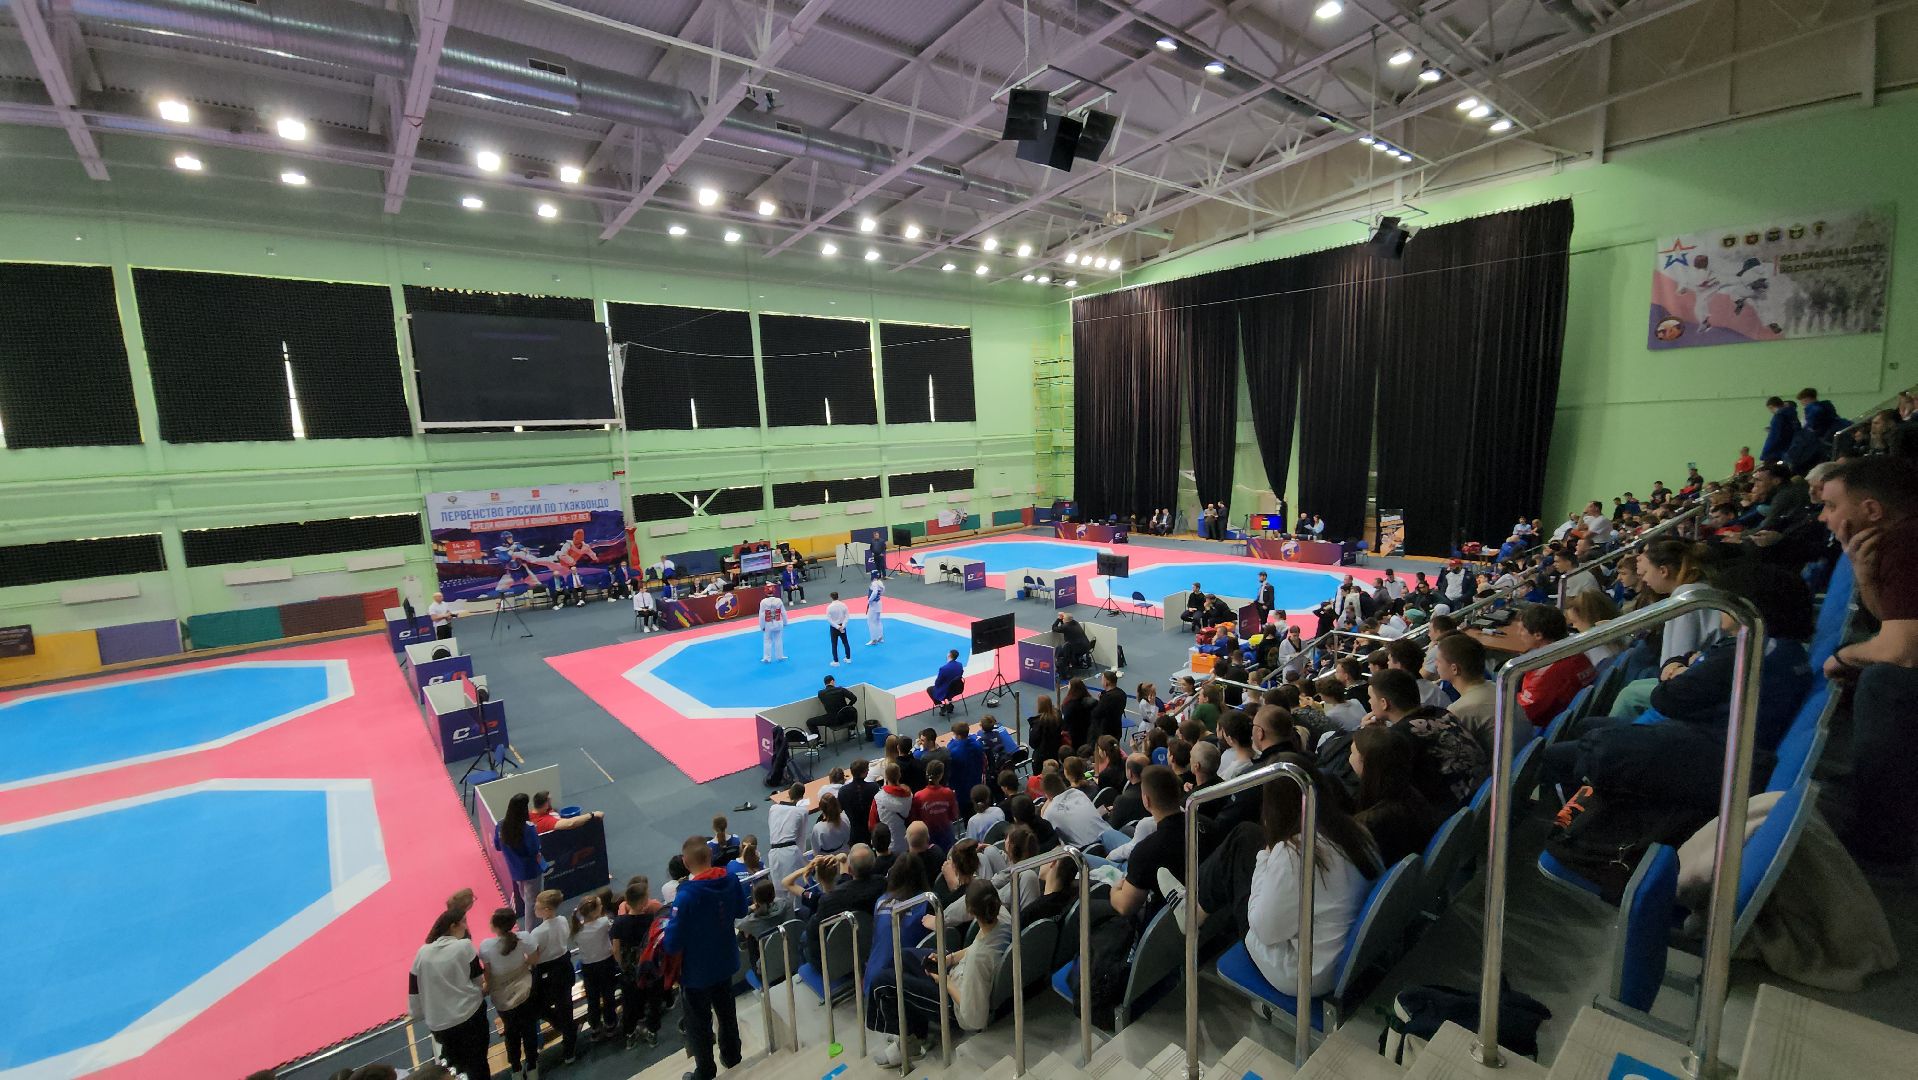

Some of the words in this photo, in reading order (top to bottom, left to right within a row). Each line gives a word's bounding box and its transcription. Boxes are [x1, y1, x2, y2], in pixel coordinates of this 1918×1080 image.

[441, 507, 504, 522] ПЕРВЕНСТВО
[506, 503, 542, 517] РОССИИ
[545, 502, 556, 513] ПО
[558, 498, 609, 512] ТХЭКВОНДО
